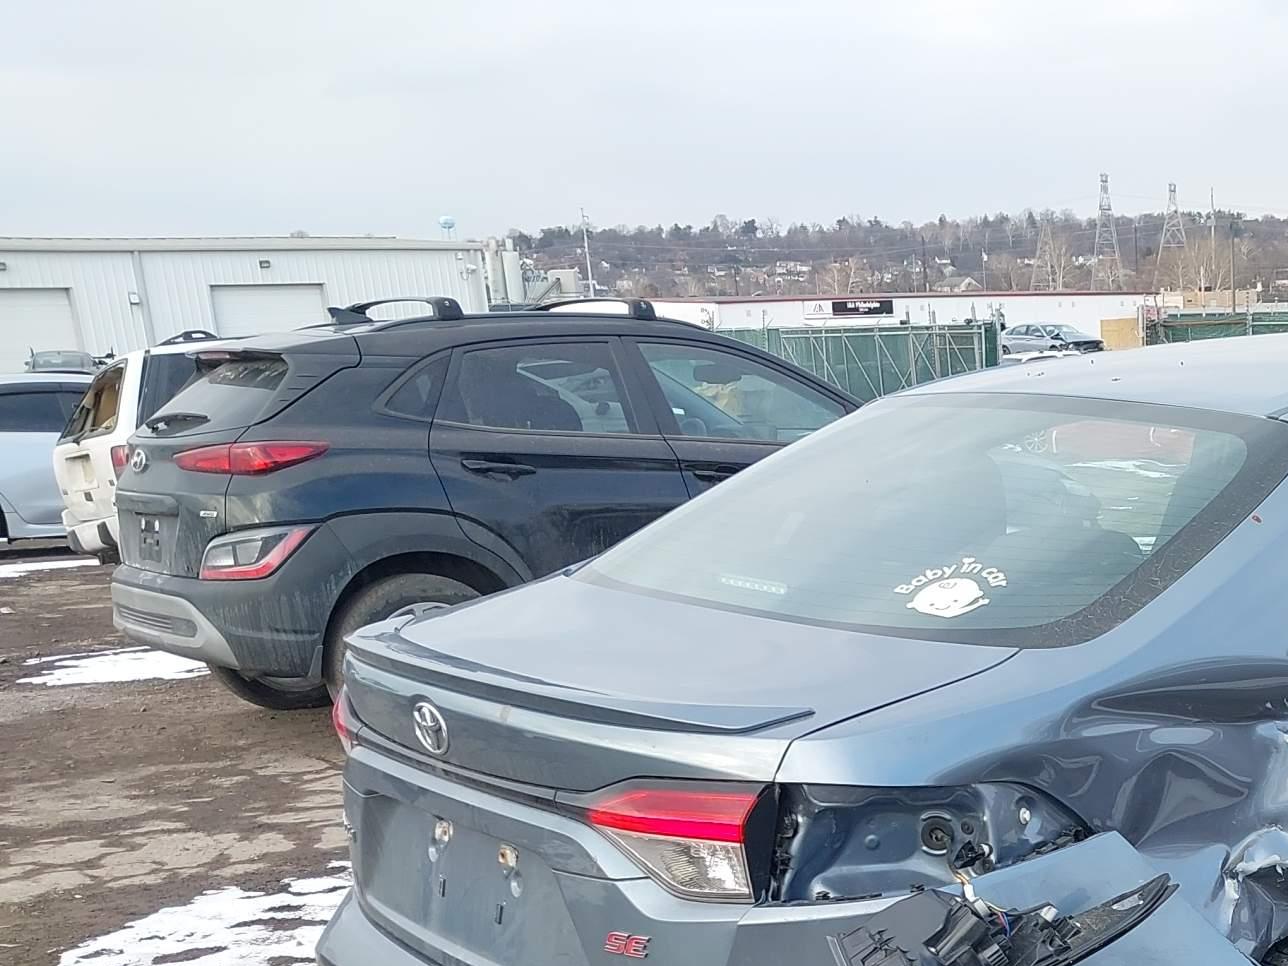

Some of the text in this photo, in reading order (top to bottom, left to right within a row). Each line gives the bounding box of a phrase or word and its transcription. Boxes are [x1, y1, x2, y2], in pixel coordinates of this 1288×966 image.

[893, 564, 958, 594] Baby
[980, 567, 1008, 588] car
[603, 930, 652, 959] SE
